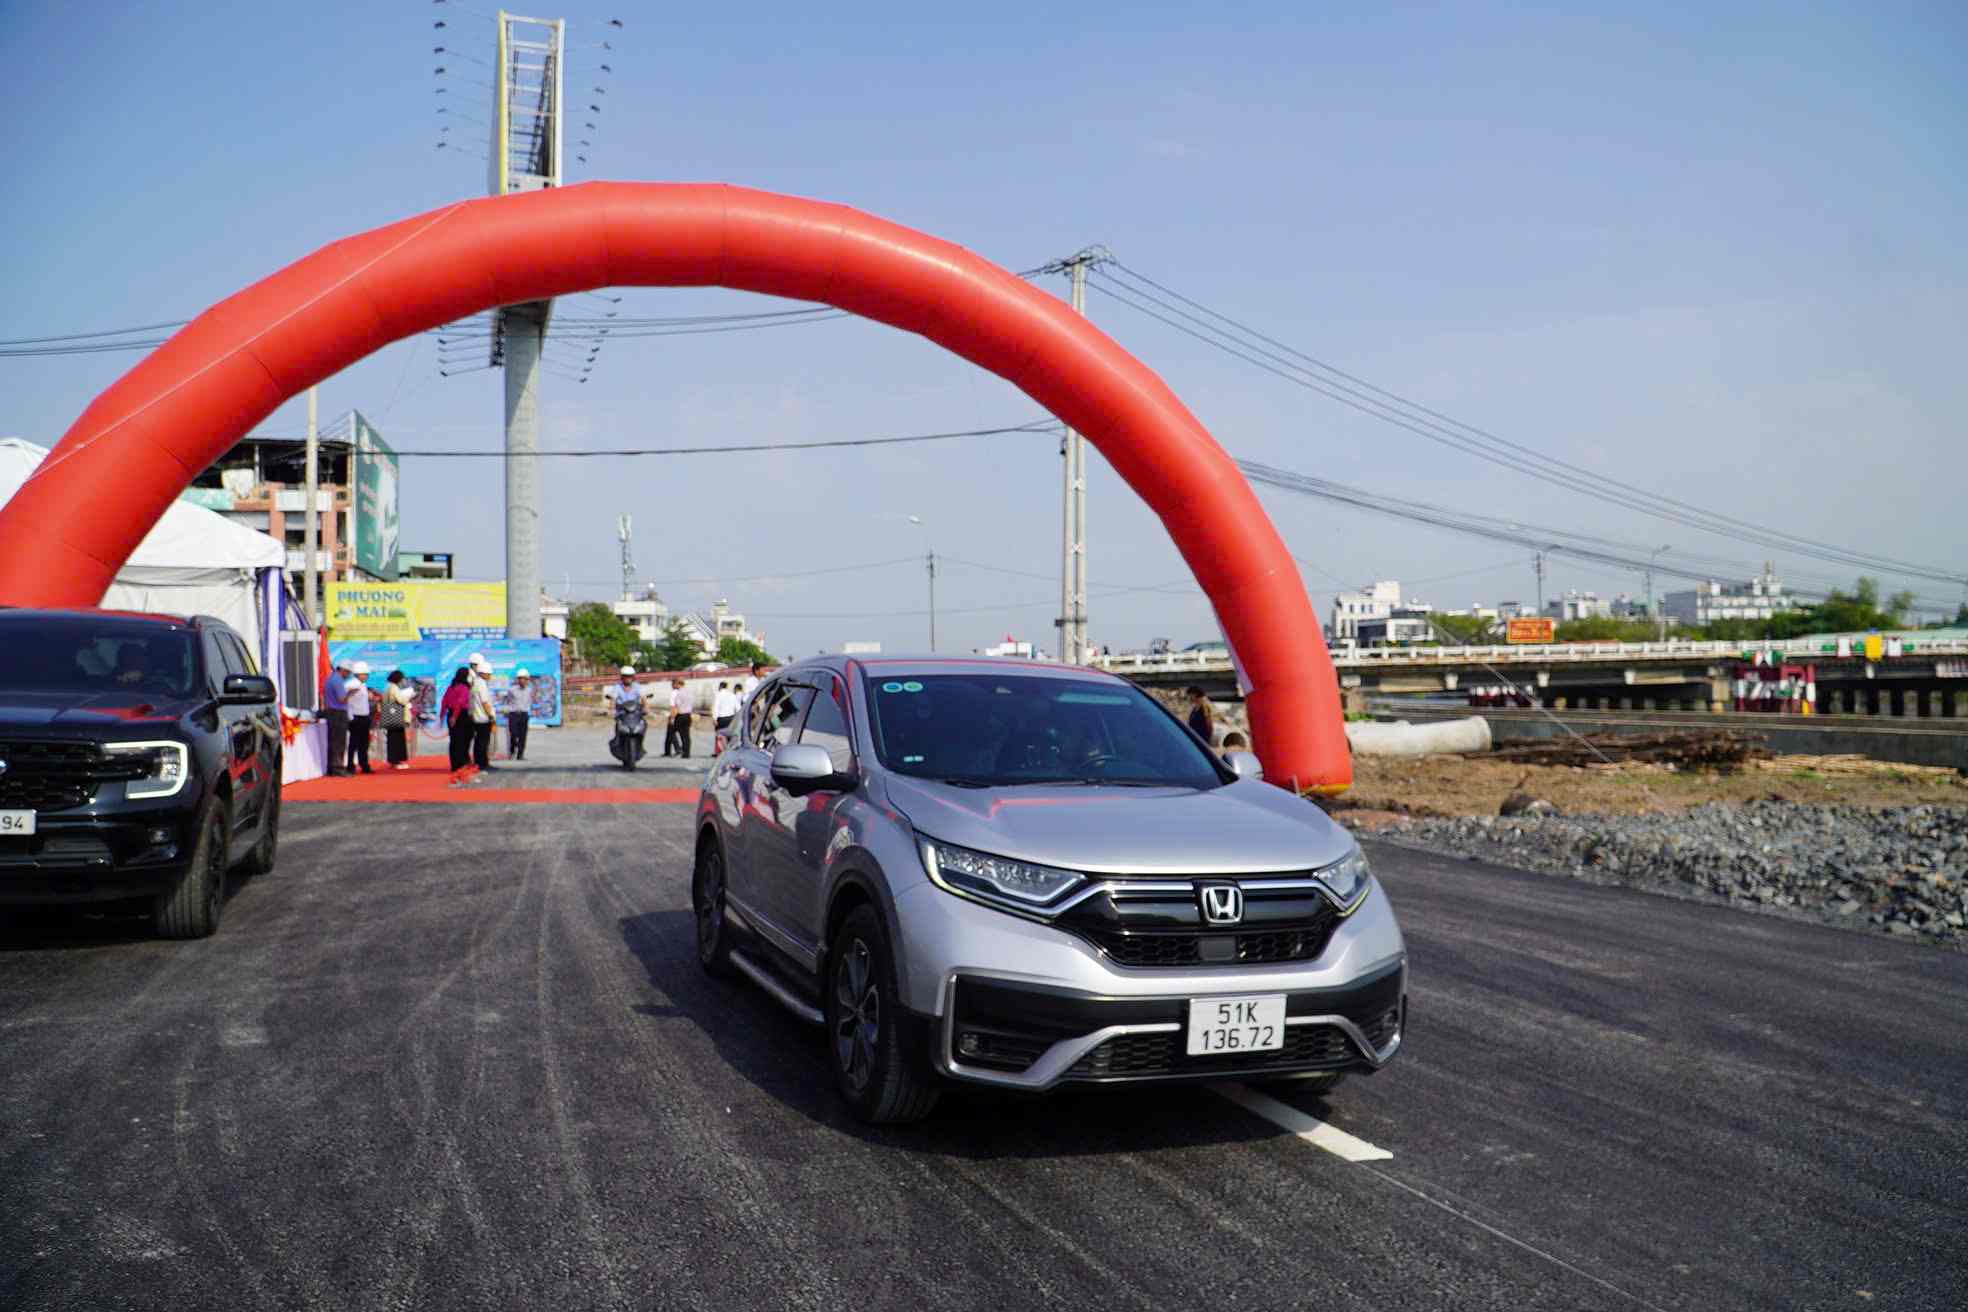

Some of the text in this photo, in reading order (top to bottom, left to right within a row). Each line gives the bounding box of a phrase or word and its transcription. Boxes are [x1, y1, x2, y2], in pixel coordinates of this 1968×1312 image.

[356, 606, 386, 618] MAI
[1218, 1001, 1258, 1025] 51K
[1202, 1025, 1273, 1050] 136.72
